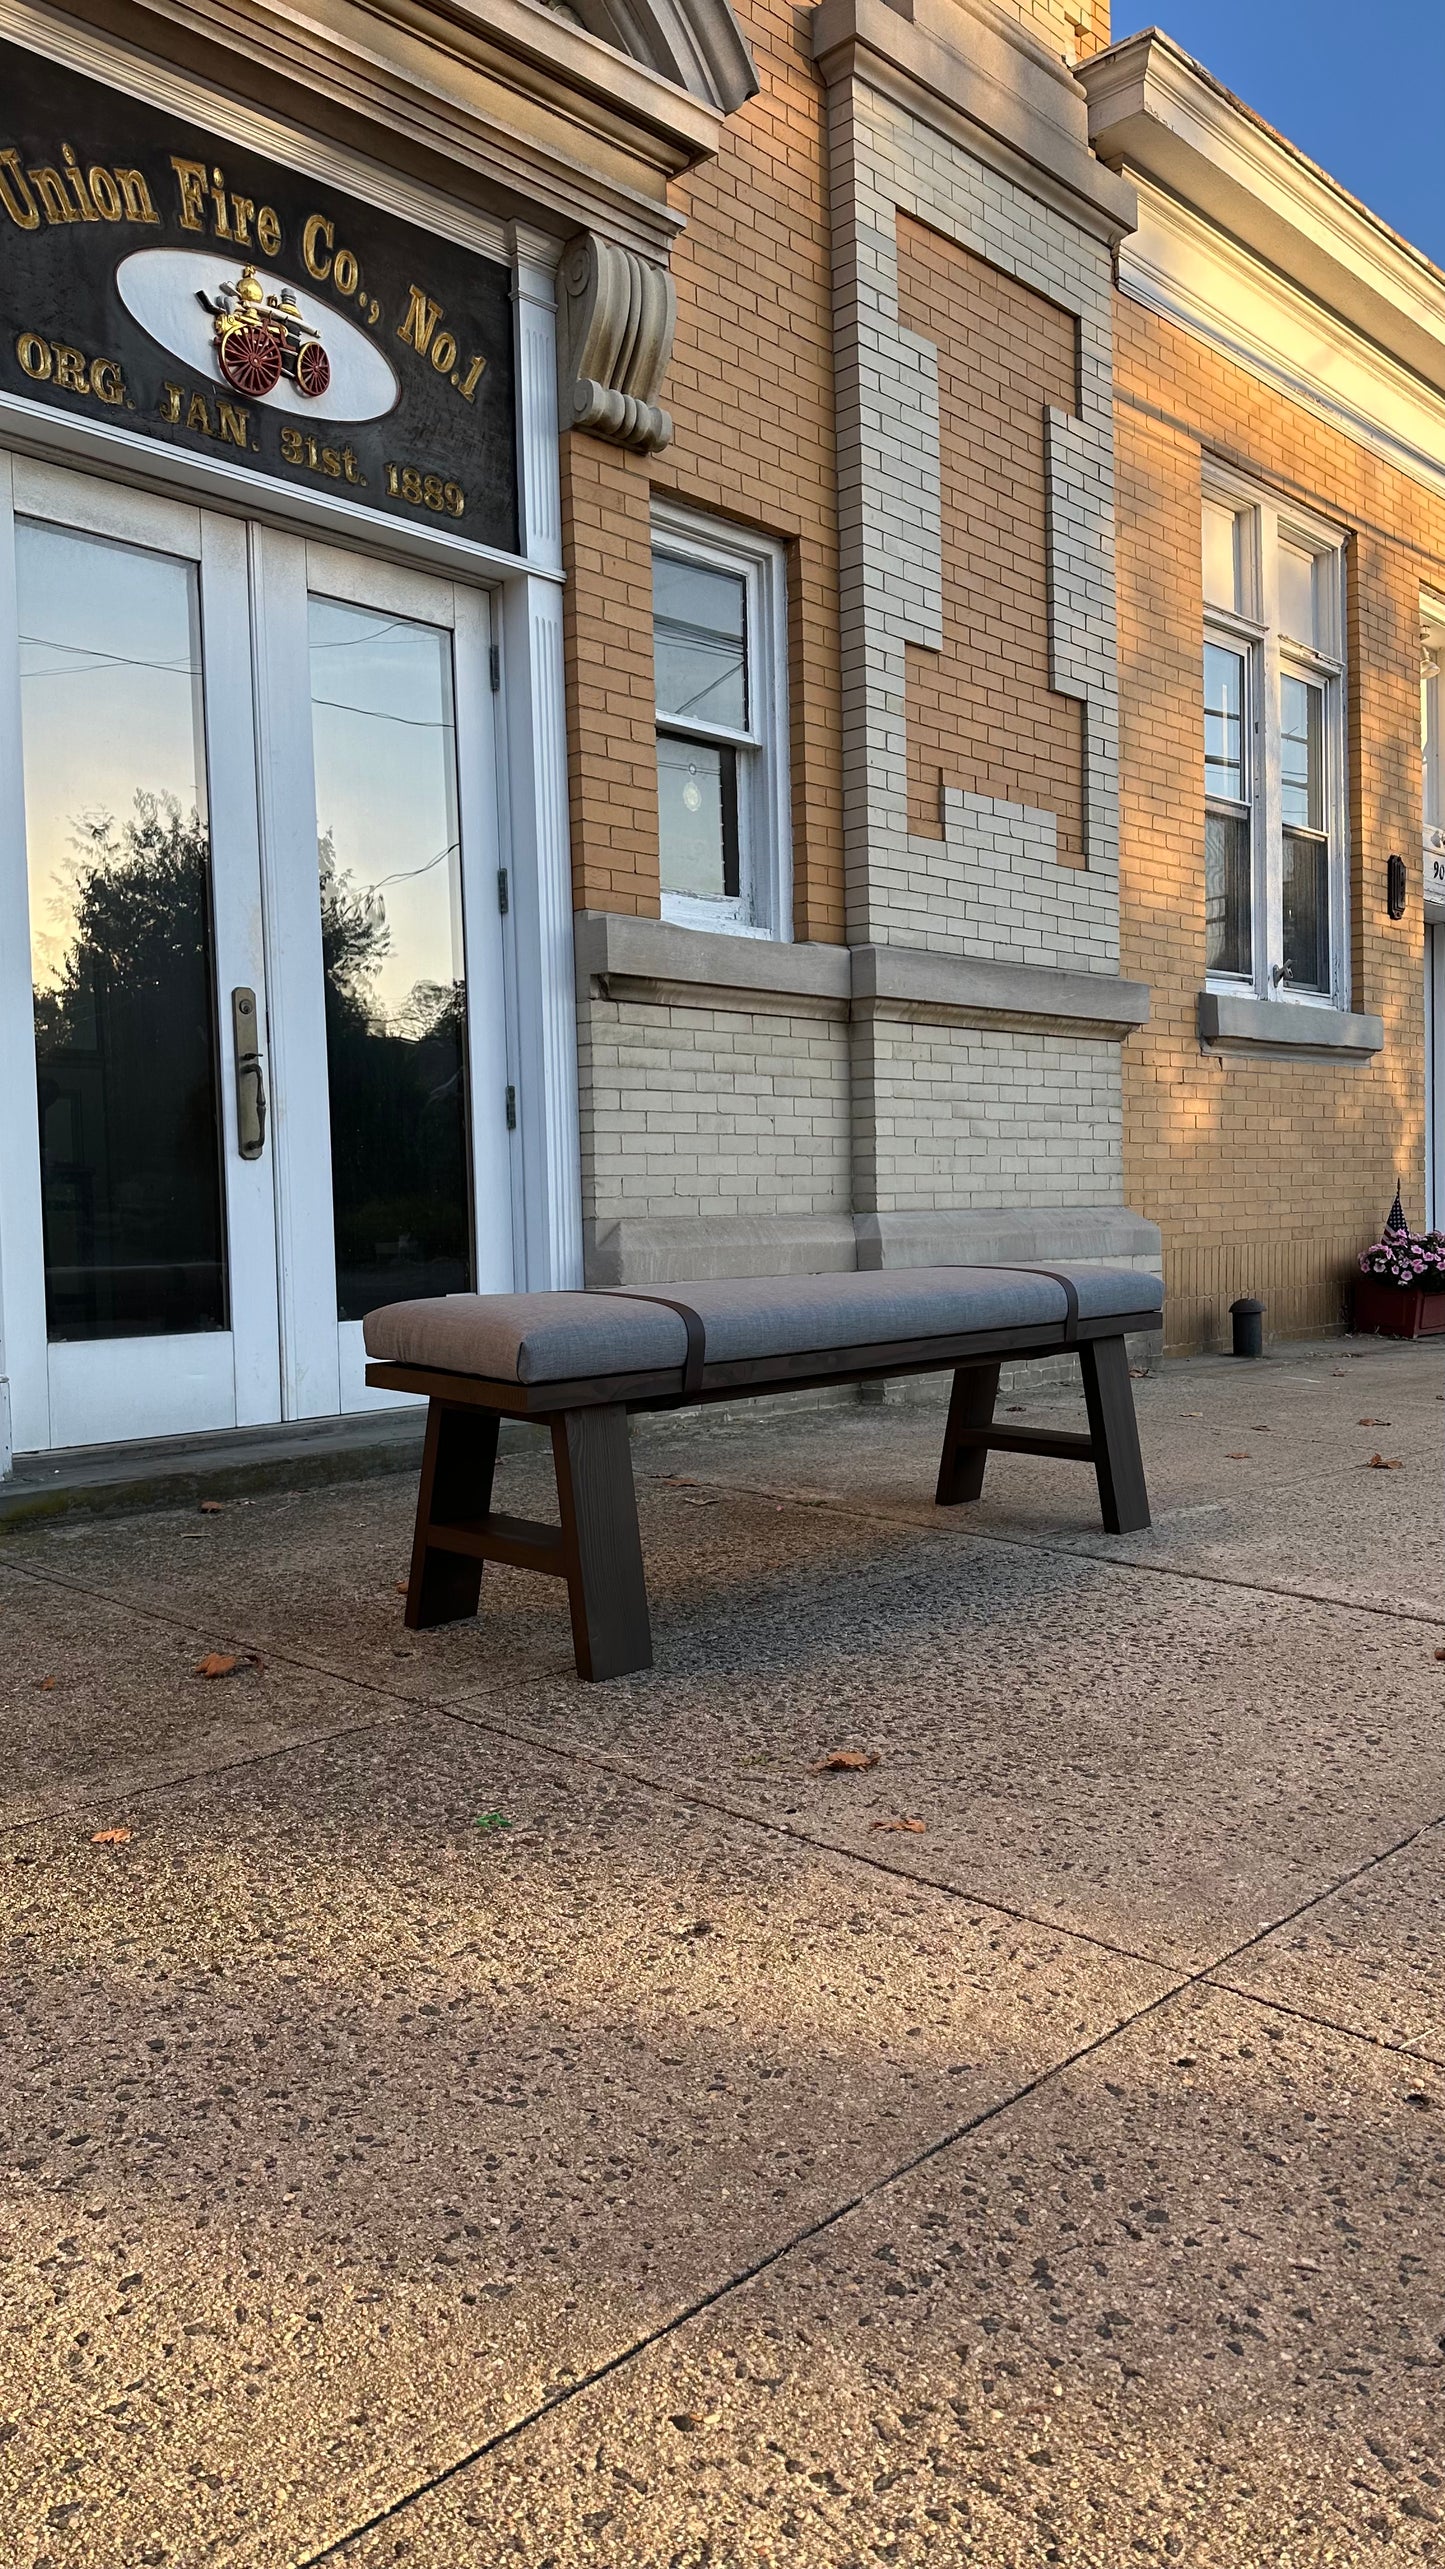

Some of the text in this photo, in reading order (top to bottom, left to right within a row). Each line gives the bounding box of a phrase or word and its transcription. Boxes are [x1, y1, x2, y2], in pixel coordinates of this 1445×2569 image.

[0, 143, 158, 230] Union
[170, 155, 282, 256] Fire
[303, 214, 383, 324] Co.,
[16, 331, 466, 517] ORG. JAN. 31st. 1889
